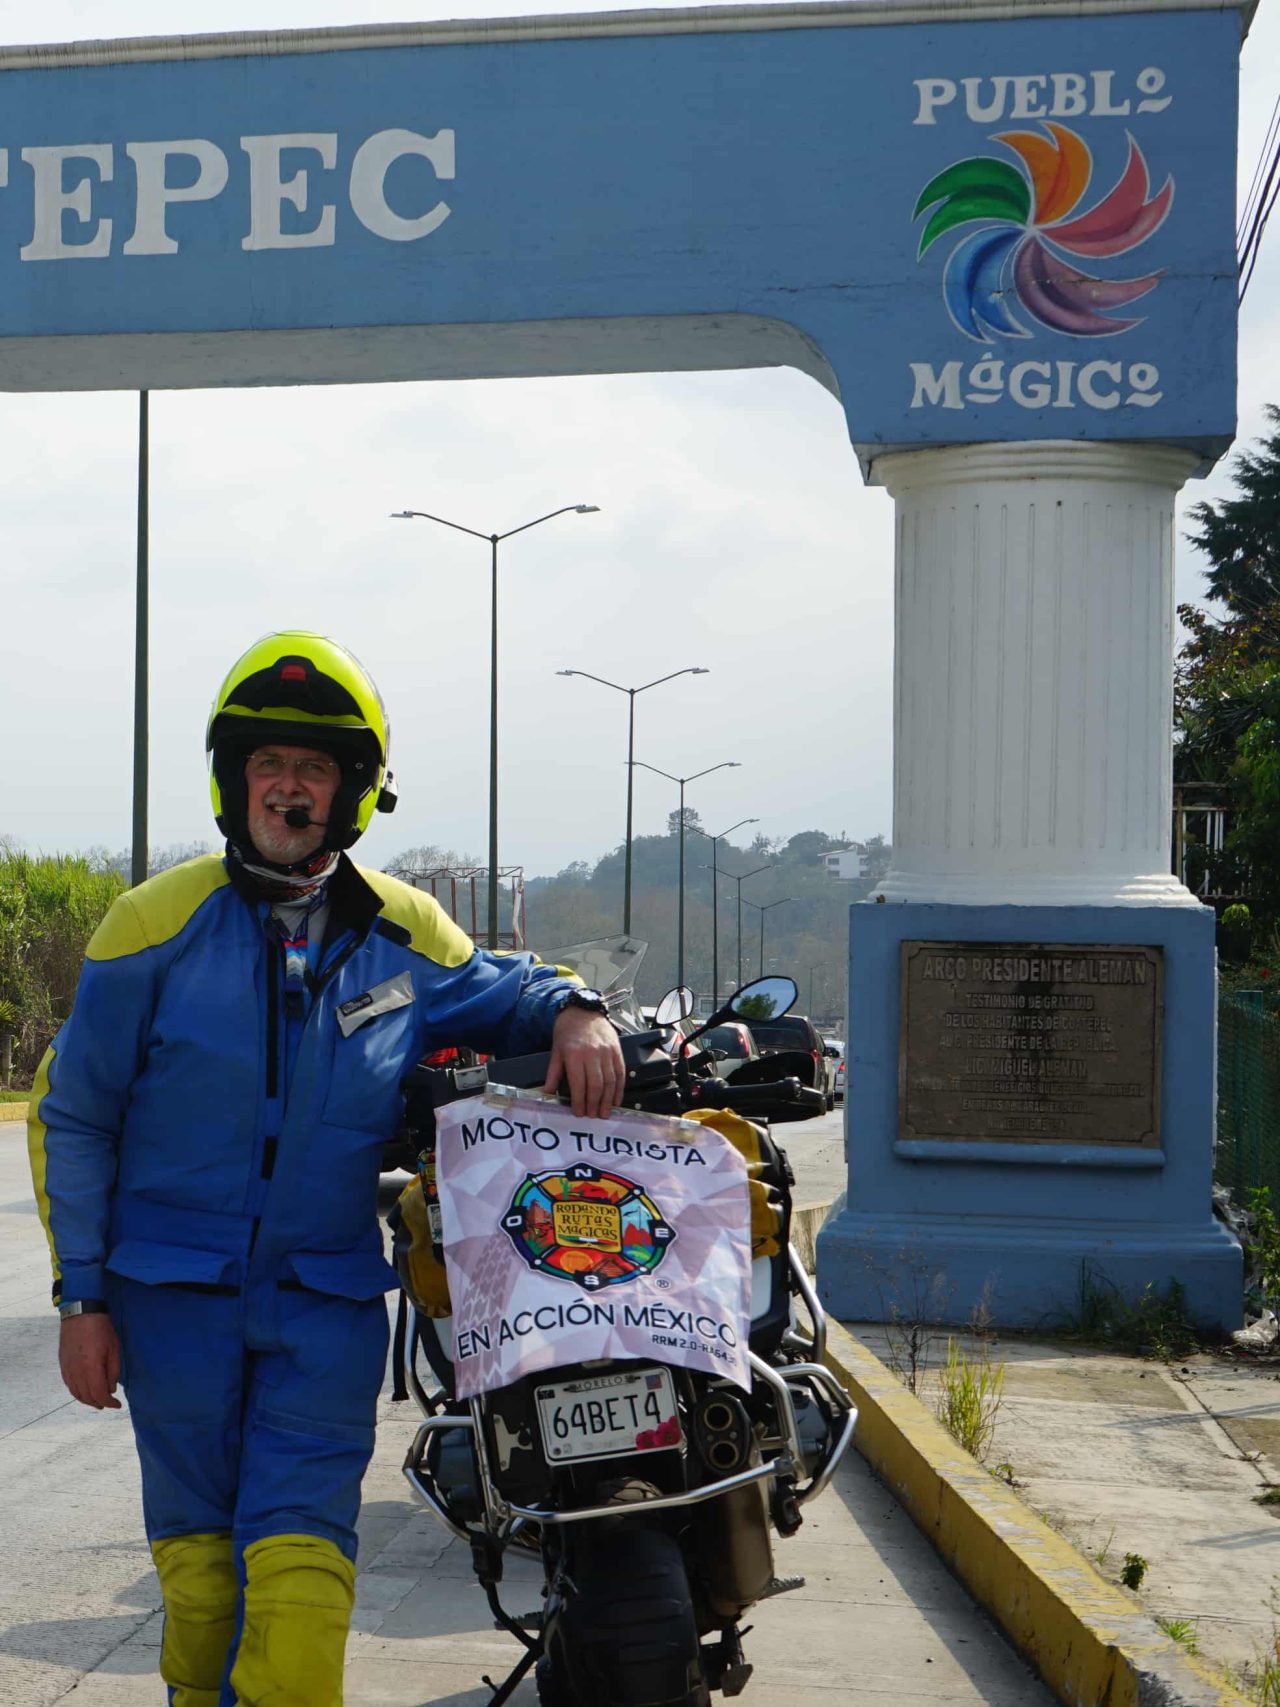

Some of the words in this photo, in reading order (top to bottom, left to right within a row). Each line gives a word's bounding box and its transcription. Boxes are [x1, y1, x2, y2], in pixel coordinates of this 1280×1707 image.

[912, 67, 1173, 125] PUEBLO
[923, 957, 967, 980] ARCO
[971, 957, 1072, 983] PRESIDENTE
[461, 1117, 560, 1151] MOTO
[569, 1131, 707, 1166] TURISTA
[574, 1168, 593, 1178] N
[654, 1228, 669, 1238] E
[584, 1274, 600, 1286] S
[457, 1327, 491, 1359] EN
[498, 1298, 614, 1346] ACCIÓN
[624, 1303, 737, 1348] MÉXICO
[652, 1334, 677, 1347] RRM
[553, 1391, 661, 1438] 64BET4
